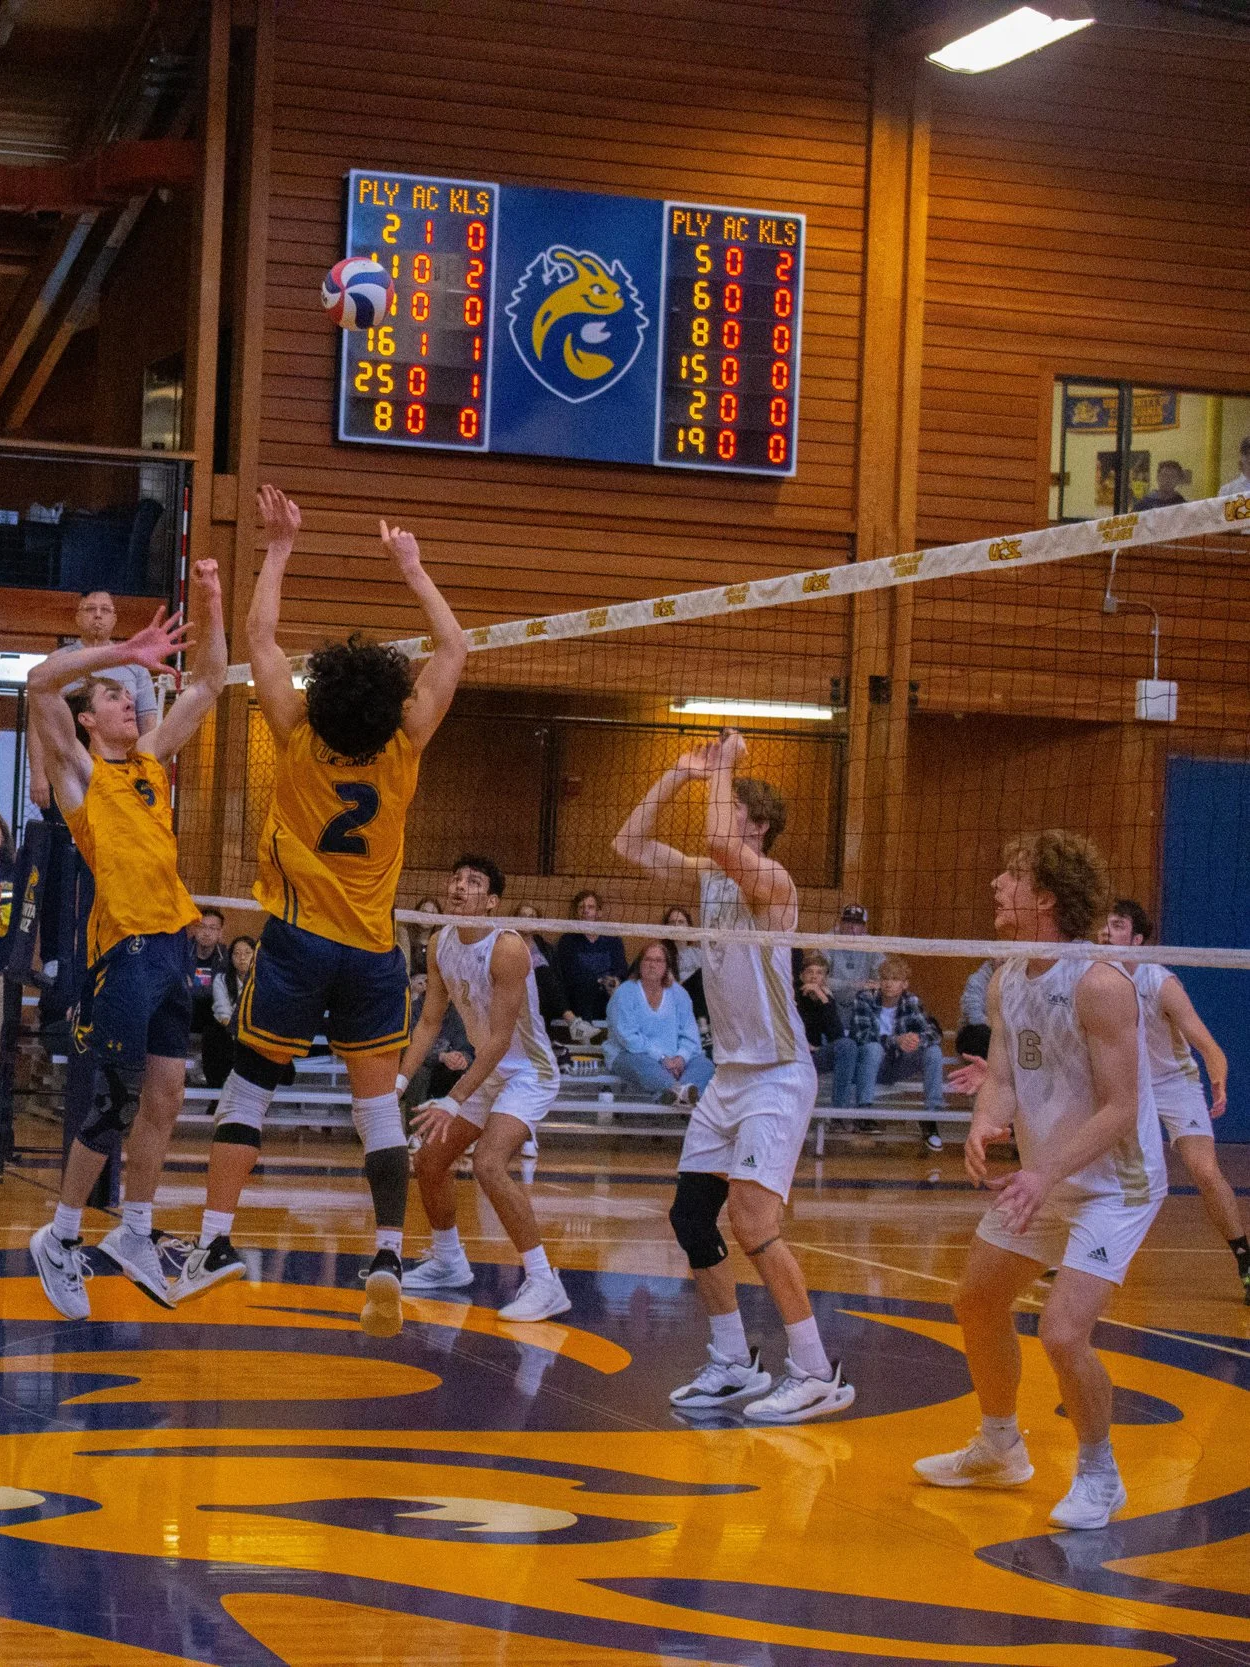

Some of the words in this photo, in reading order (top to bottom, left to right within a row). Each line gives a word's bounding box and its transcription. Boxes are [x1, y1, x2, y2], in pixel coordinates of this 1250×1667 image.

[359, 179, 399, 206] PLY
[412, 185, 439, 211] AC
[449, 188, 489, 216] KLS
[382, 213, 401, 244] 2
[425, 220, 433, 244] 1
[467, 221, 486, 252] 0
[673, 210, 711, 237] PLY
[723, 216, 749, 241] AC
[758, 219, 797, 246] KLS
[413, 253, 432, 284] 0
[465, 259, 485, 289] 2
[695, 244, 712, 274] 5
[725, 246, 743, 277] 0
[776, 251, 793, 281] 2
[411, 291, 430, 322] 0
[464, 295, 483, 326] 0
[693, 280, 711, 310] 6
[724, 282, 742, 313] 0
[774, 287, 792, 318] 0
[367, 325, 396, 357] 16
[421, 332, 429, 357] 1
[474, 337, 481, 361] 1
[692, 317, 710, 347] 8
[722, 319, 741, 350] 0
[773, 323, 791, 354] 0
[354, 361, 394, 394] 25
[408, 365, 427, 397] 0
[472, 374, 480, 398] 1
[681, 353, 708, 383] 15
[721, 356, 739, 386] 0
[771, 360, 789, 391] 0
[374, 401, 393, 432] 8
[406, 403, 425, 434] 0
[459, 407, 478, 439] 0
[689, 390, 707, 420] 2
[720, 392, 738, 423] 0
[770, 397, 788, 427] 0
[677, 427, 705, 454] 19
[718, 429, 736, 459] 0
[768, 433, 786, 464] 0
[315, 781, 382, 857] 2
[1018, 1029, 1043, 1071] 6
